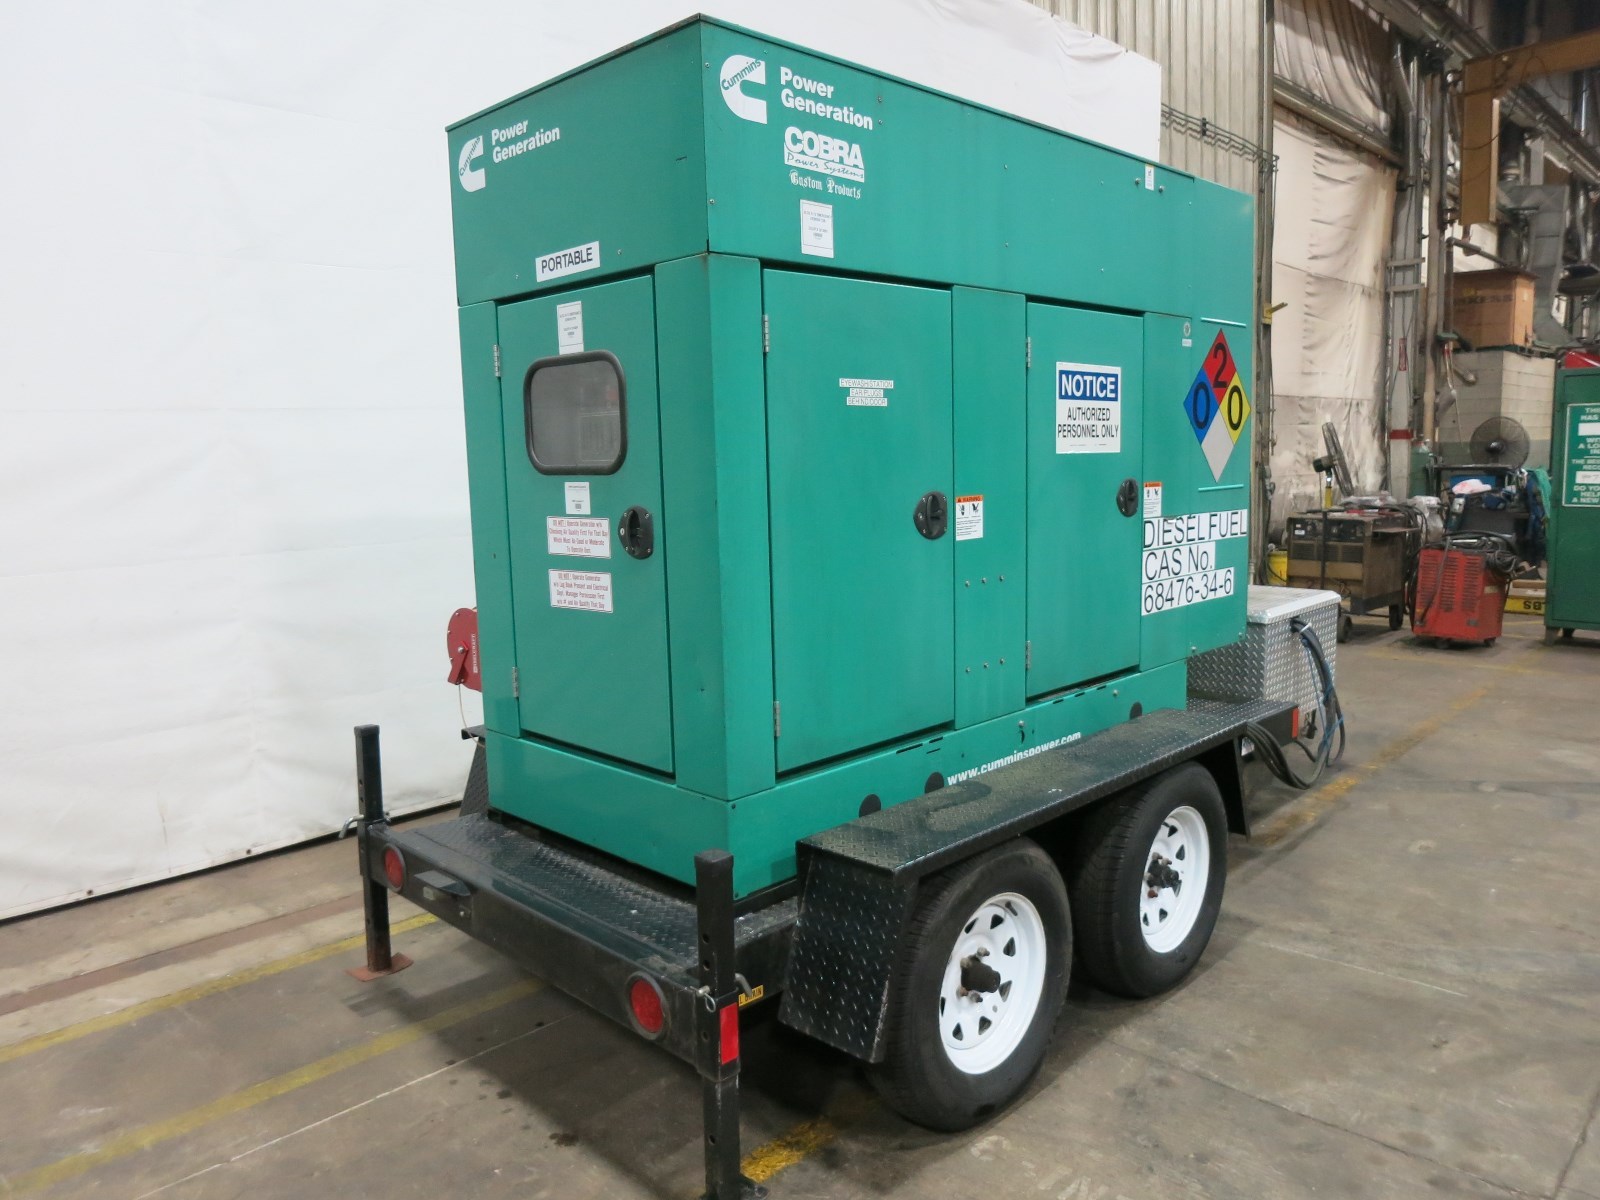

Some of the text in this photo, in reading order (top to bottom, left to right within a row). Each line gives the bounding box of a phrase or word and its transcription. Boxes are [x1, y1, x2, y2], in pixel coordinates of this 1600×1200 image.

[721, 59, 762, 90] Cummins
[780, 66, 834, 98] Power
[781, 88, 873, 130] Generation
[492, 120, 528, 146] Power
[492, 127, 560, 164] Generation
[785, 126, 864, 170] COBRA
[786, 152, 864, 178] Power Systems
[789, 169, 861, 200] Custom Products
[541, 247, 593, 274] PORTABLE
[1213, 342, 1228, 388] 2
[1061, 374, 1116, 398] NOTICE
[1067, 406, 1110, 422] AUTHORIZED
[1192, 382, 1244, 431] 0 0
[1058, 424, 1118, 438] PERSONNEL ONLY
[1144, 512, 1247, 548] DIESEL FUEL
[1144, 545, 1213, 580] CAS No.
[1144, 569, 1232, 613] 68476-34-6
[947, 731, 1081, 786] www.cumminspower.com
